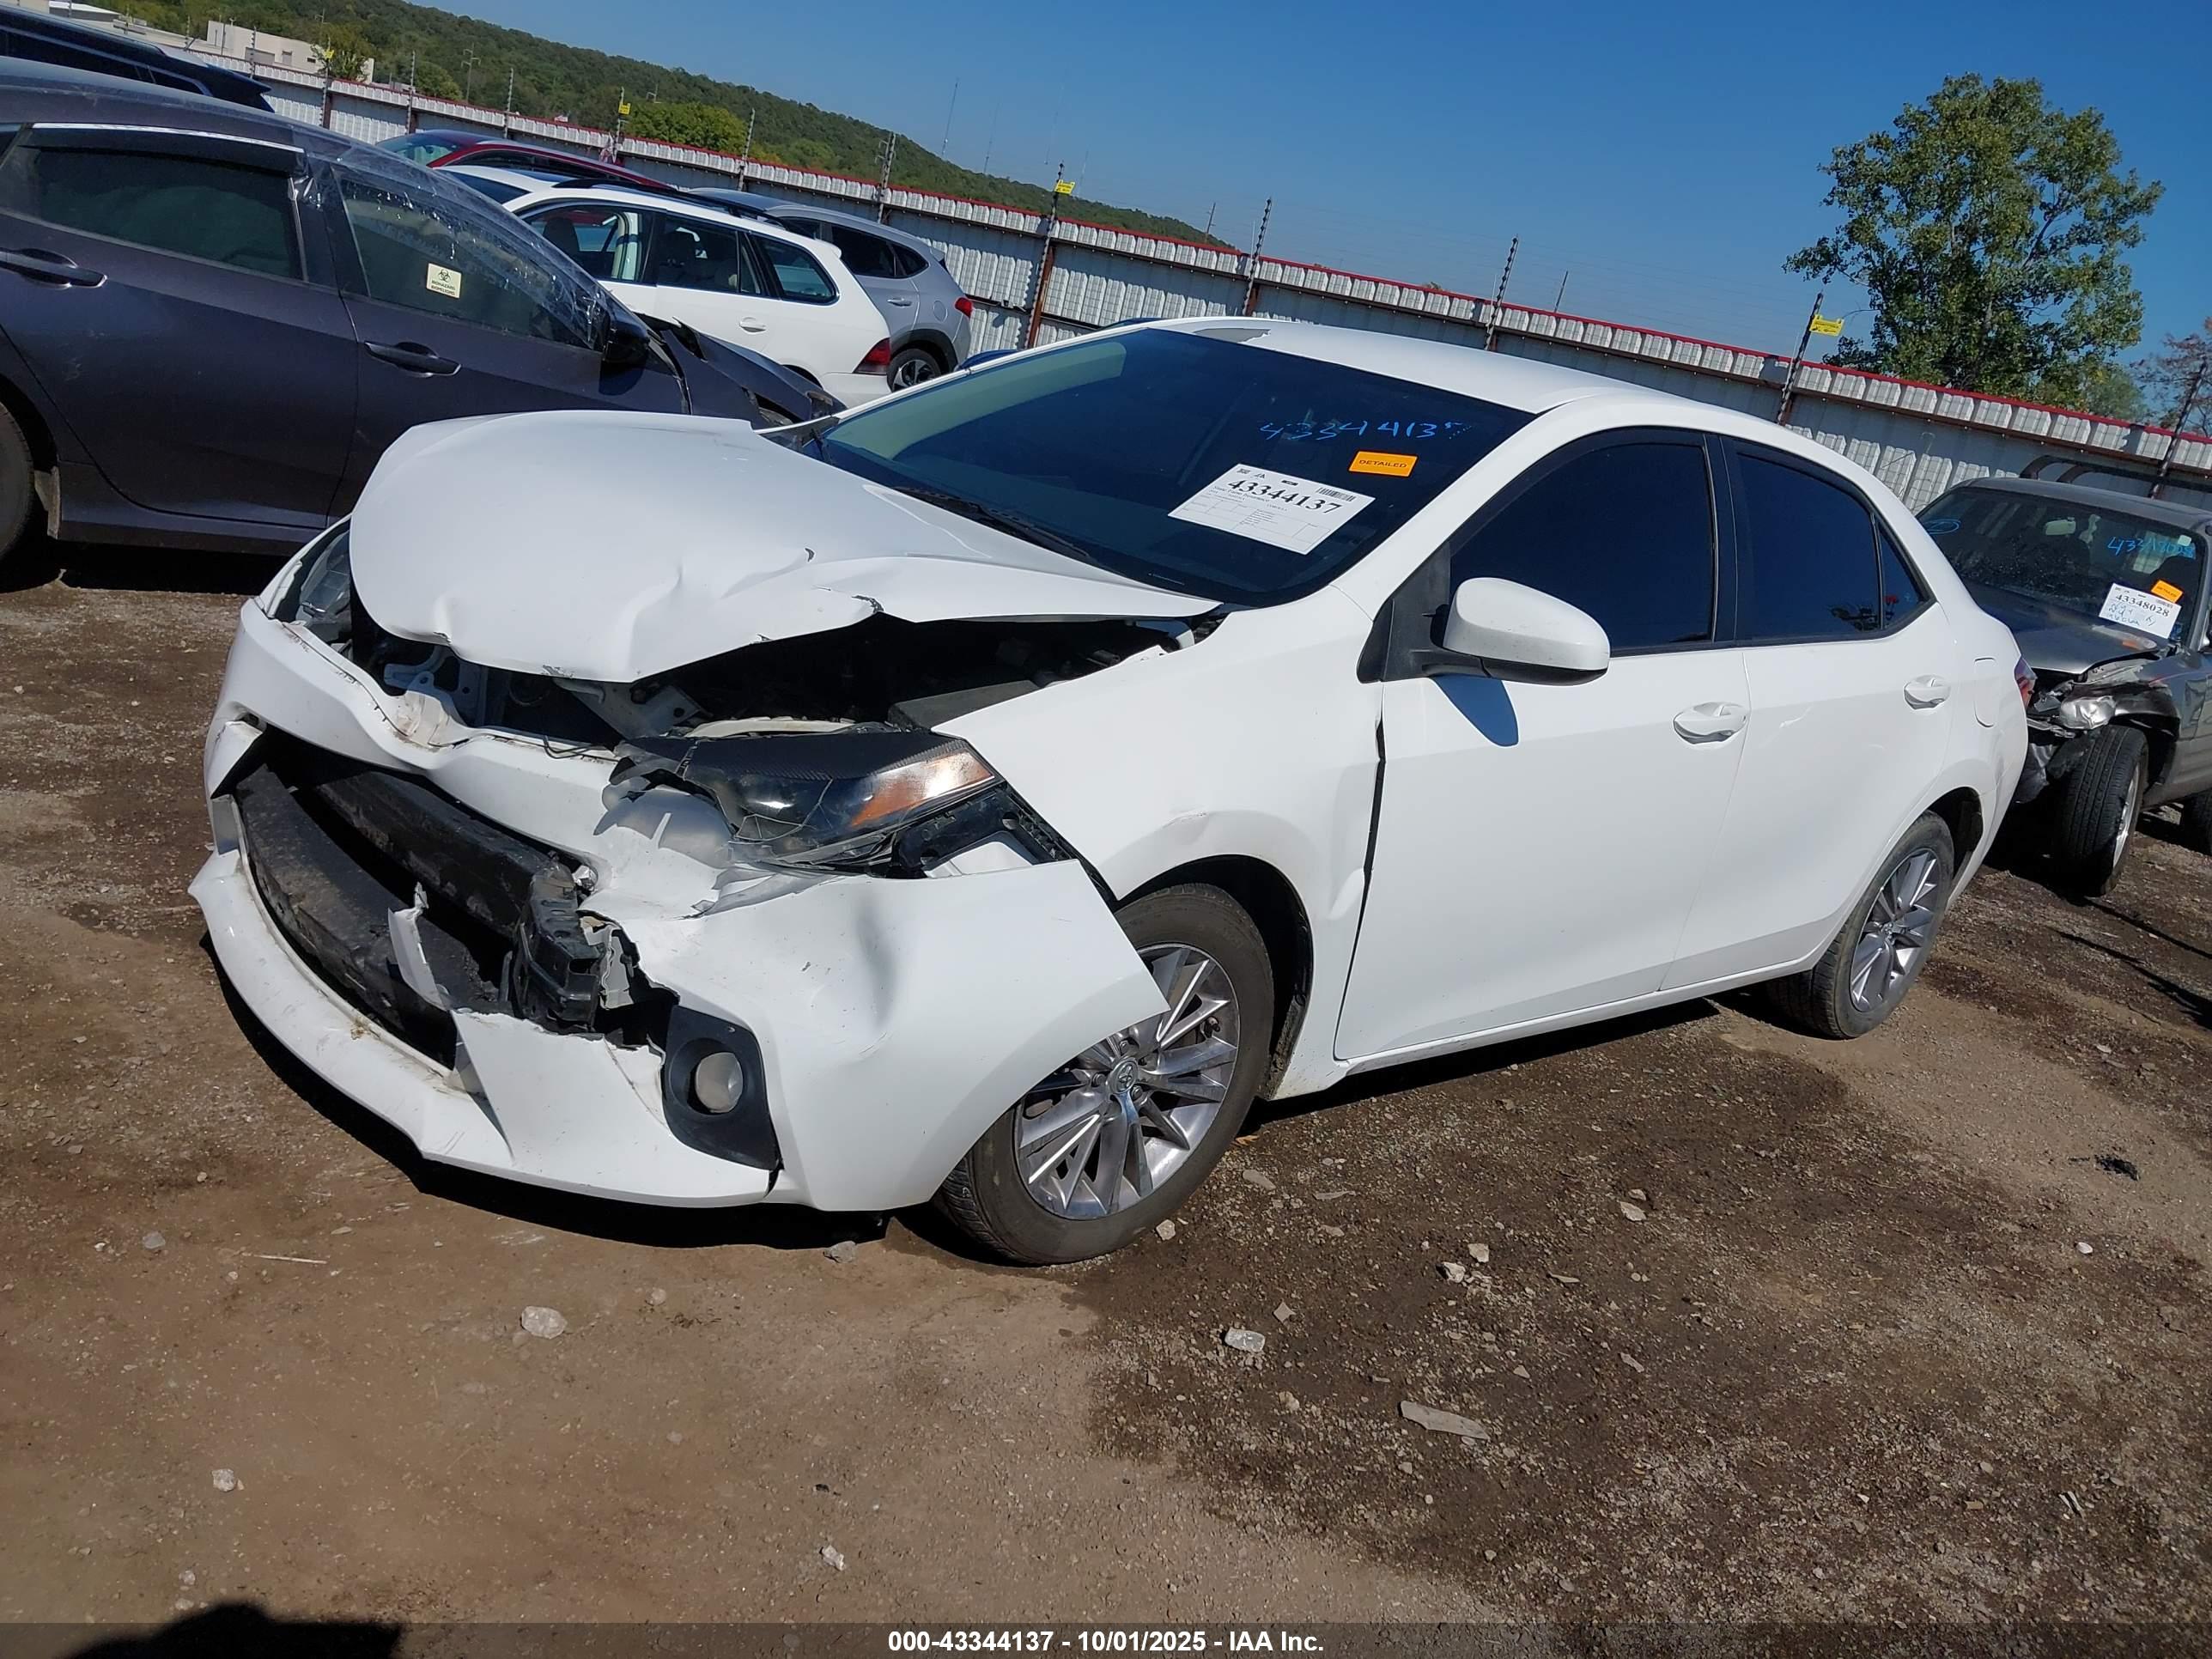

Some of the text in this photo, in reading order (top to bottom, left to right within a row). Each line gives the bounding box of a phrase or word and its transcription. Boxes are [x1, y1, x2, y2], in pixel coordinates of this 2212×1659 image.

[1358, 459, 1407, 469] DETAILED
[1227, 479, 1343, 514] 43344137
[2115, 593, 2170, 617] 43348028
